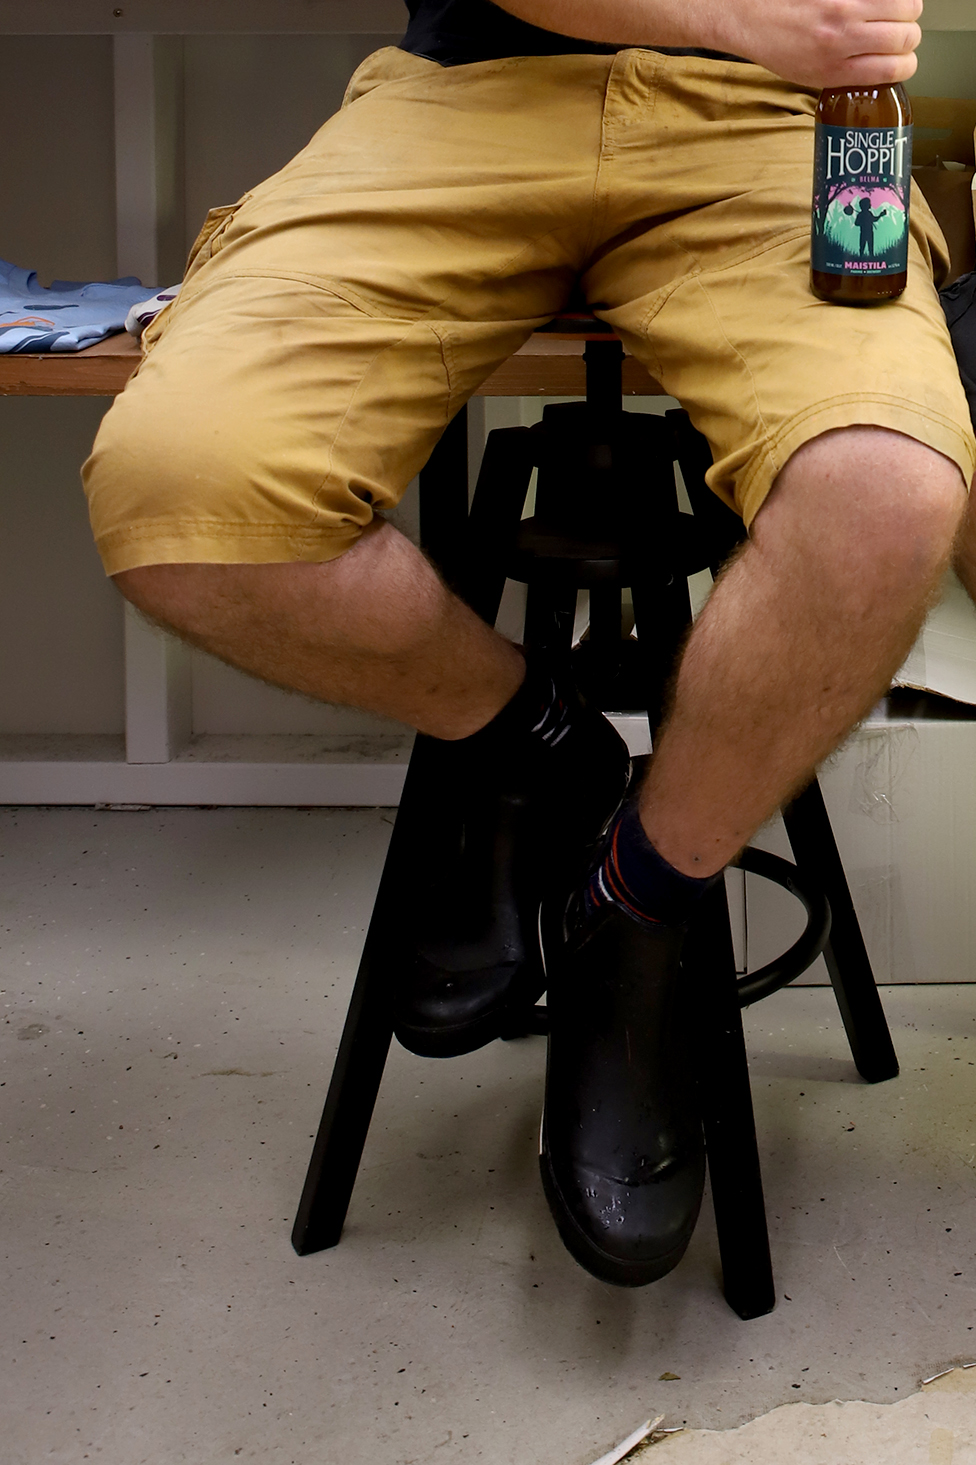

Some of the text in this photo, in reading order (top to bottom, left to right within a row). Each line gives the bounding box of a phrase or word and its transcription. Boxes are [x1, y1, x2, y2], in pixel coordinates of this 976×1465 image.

[846, 130, 894, 149] SINGLE
[826, 136, 908, 180] HOPPIT
[844, 261, 887, 270] MAISTILA
